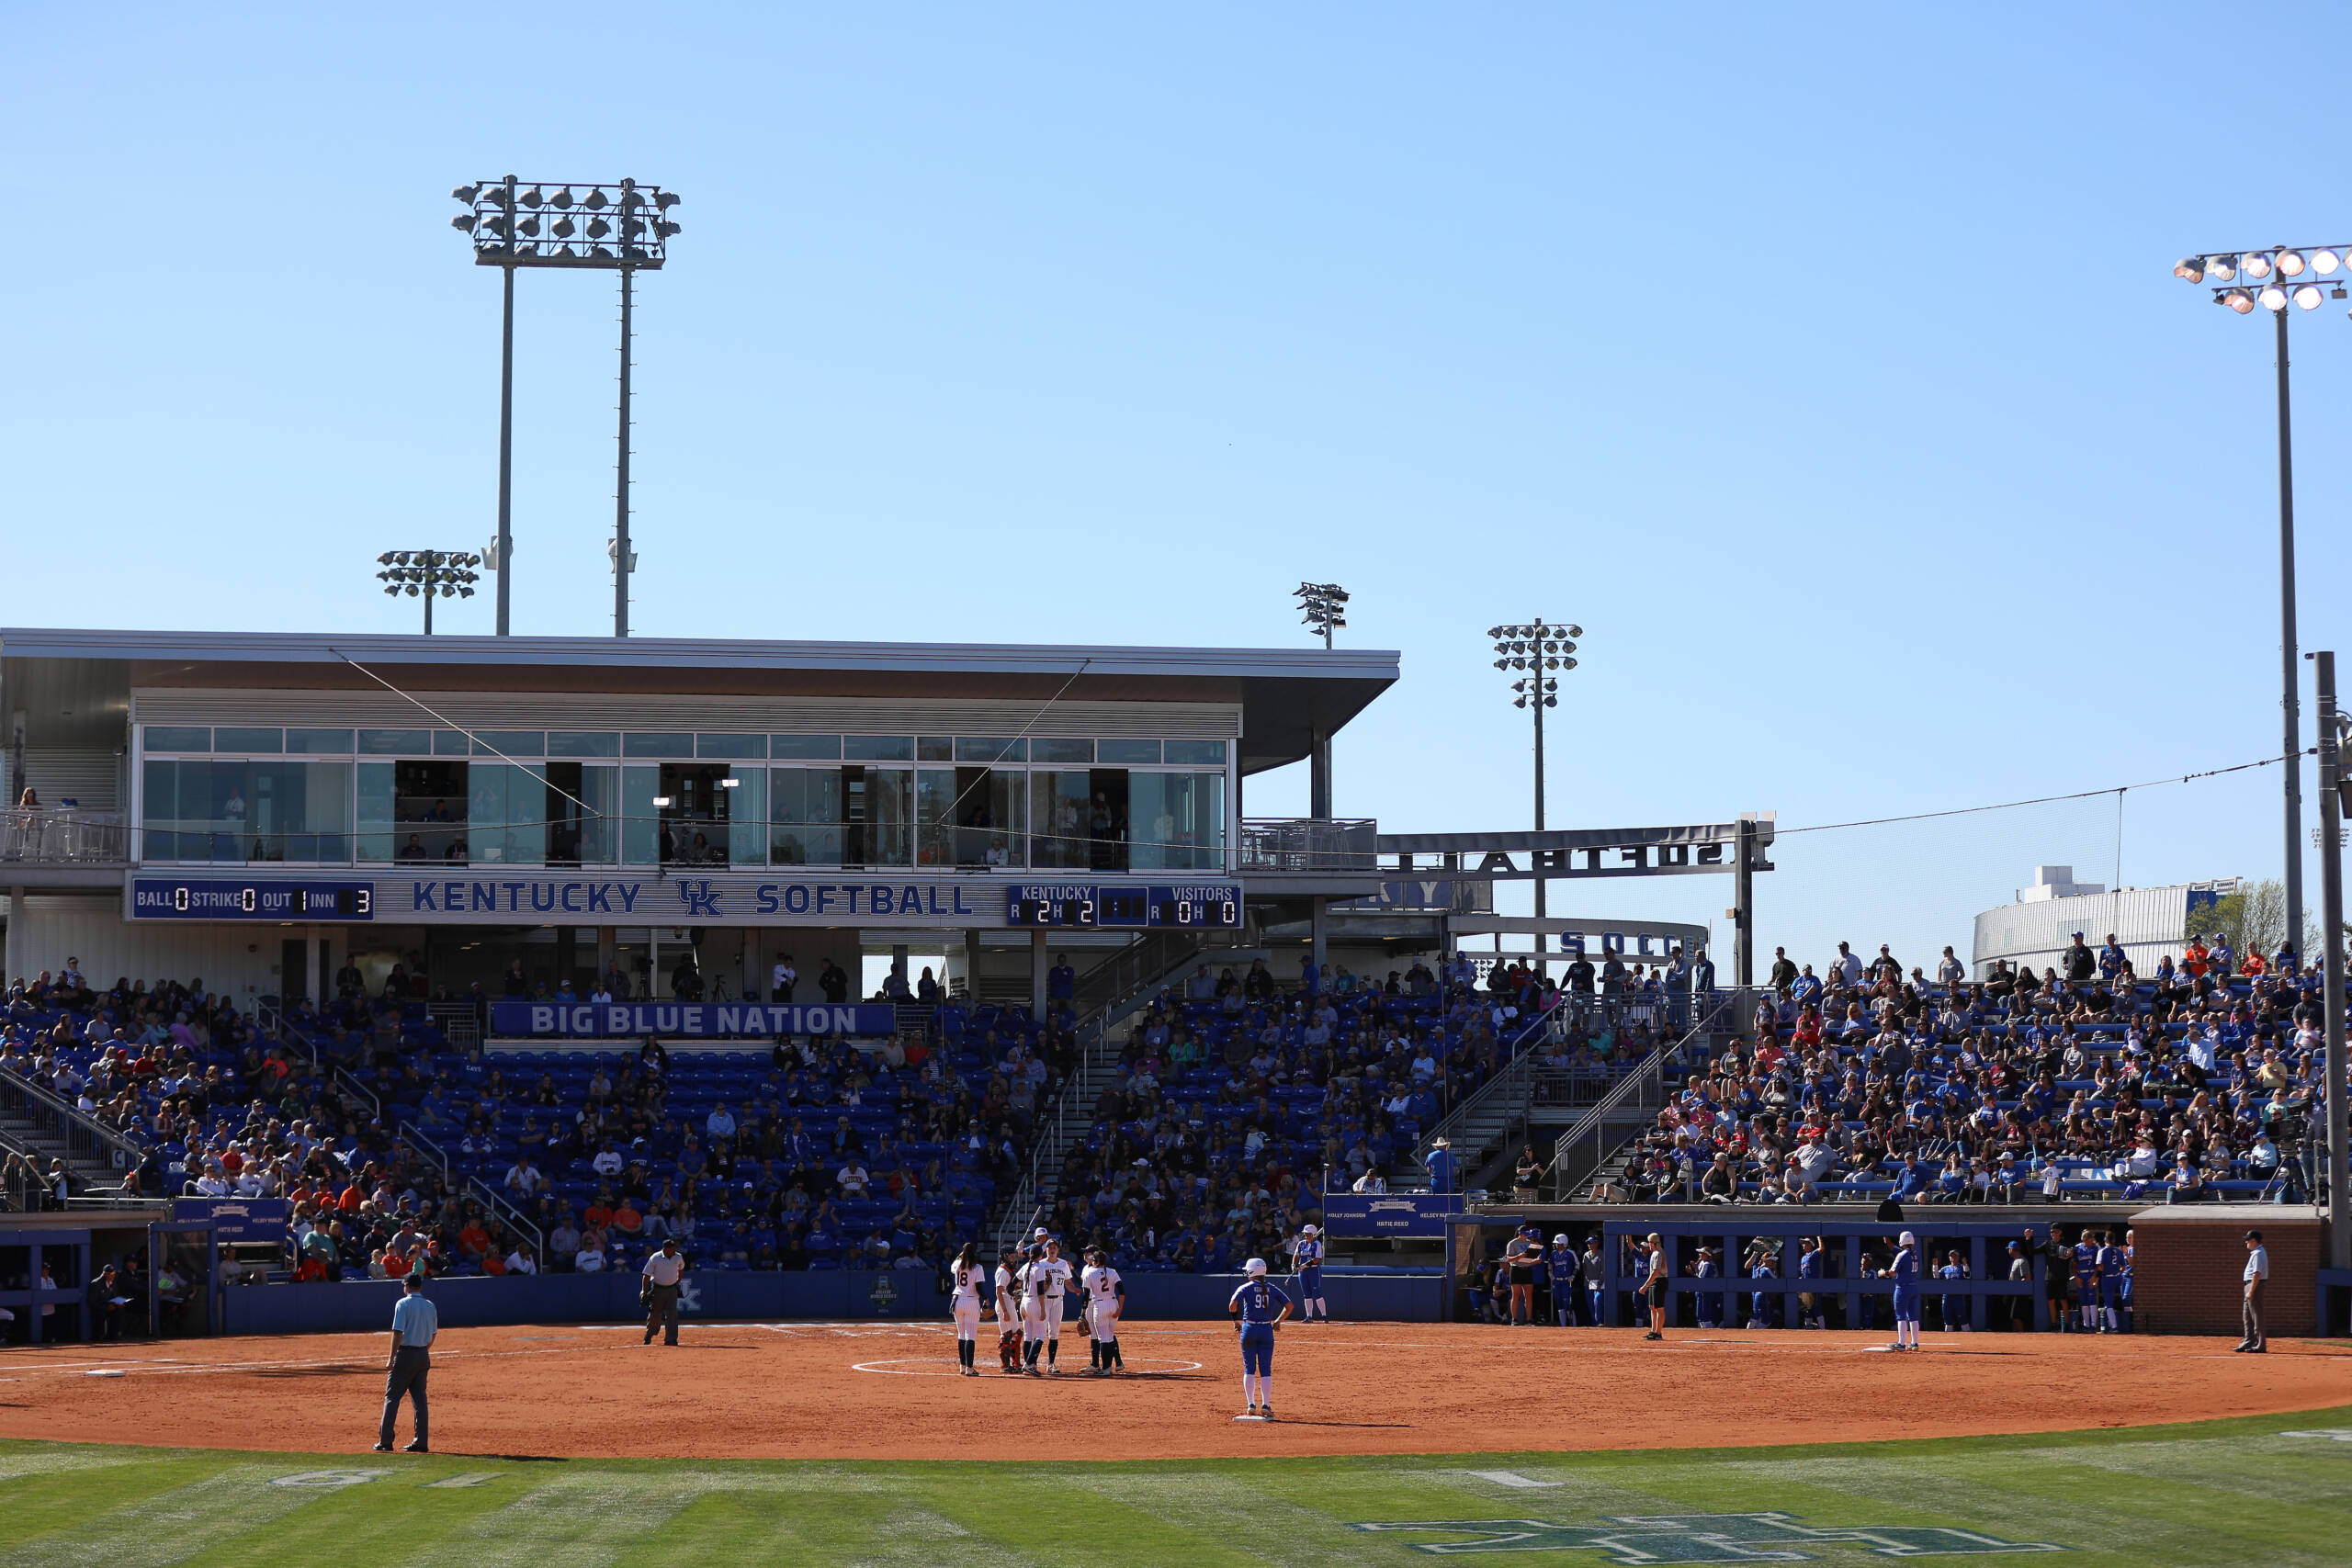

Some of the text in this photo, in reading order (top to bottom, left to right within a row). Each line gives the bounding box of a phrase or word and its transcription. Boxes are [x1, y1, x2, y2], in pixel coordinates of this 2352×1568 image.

[138, 887, 370, 912] BALL 0 STRIKE 0 OUT 1 INN 3
[413, 881, 640, 914] KENTUCKY
[676, 879, 722, 917] UK
[755, 884, 973, 915] SOFTBALL
[1022, 886, 1091, 900] KENTUCKY
[1172, 887, 1233, 901] VISITORS
[1011, 900, 1093, 923] R 2 H 2
[1151, 901, 1235, 923] R 0 H 0
[532, 1007, 856, 1034] BIG BLUE NATION
[956, 1271, 967, 1288] 18
[1057, 1277, 1065, 1285] 27
[1101, 1277, 1110, 1292] 2
